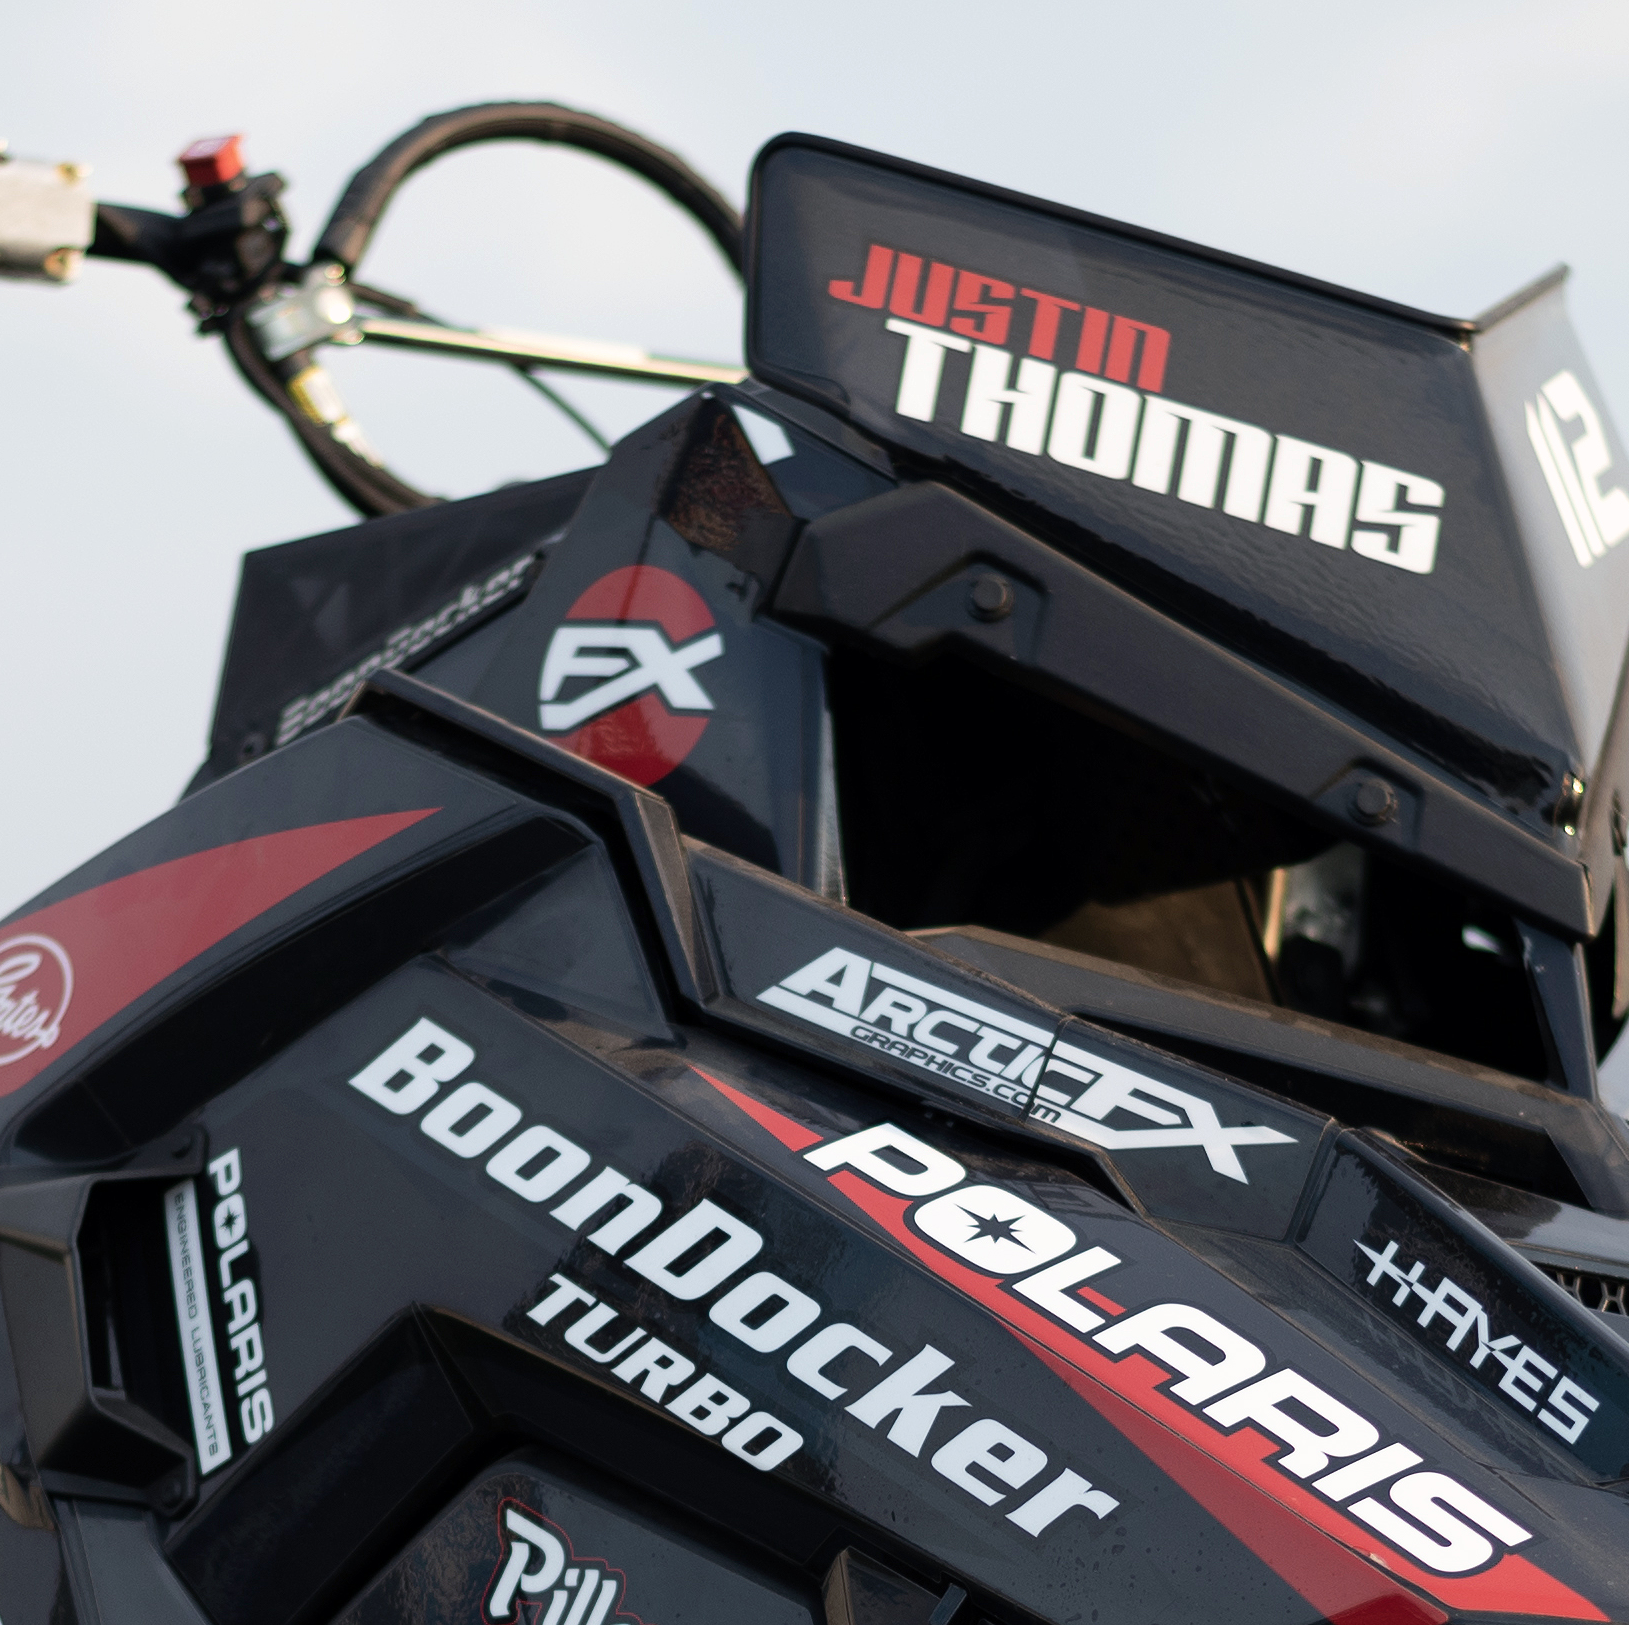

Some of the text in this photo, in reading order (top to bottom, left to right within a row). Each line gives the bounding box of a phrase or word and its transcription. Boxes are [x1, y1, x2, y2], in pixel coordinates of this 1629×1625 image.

[828, 244, 1171, 396] JUSTIN
[885, 319, 1446, 576] THOMAS
[173, 1191, 198, 1320] ENGINEERED
[208, 1147, 275, 1445] POLARIS
[347, 1016, 1120, 1538] BoonDocker
[803, 1122, 1534, 1574] POLARIS
[1353, 1239, 1601, 1445] HAYES
[525, 1272, 804, 1472] TURBO
